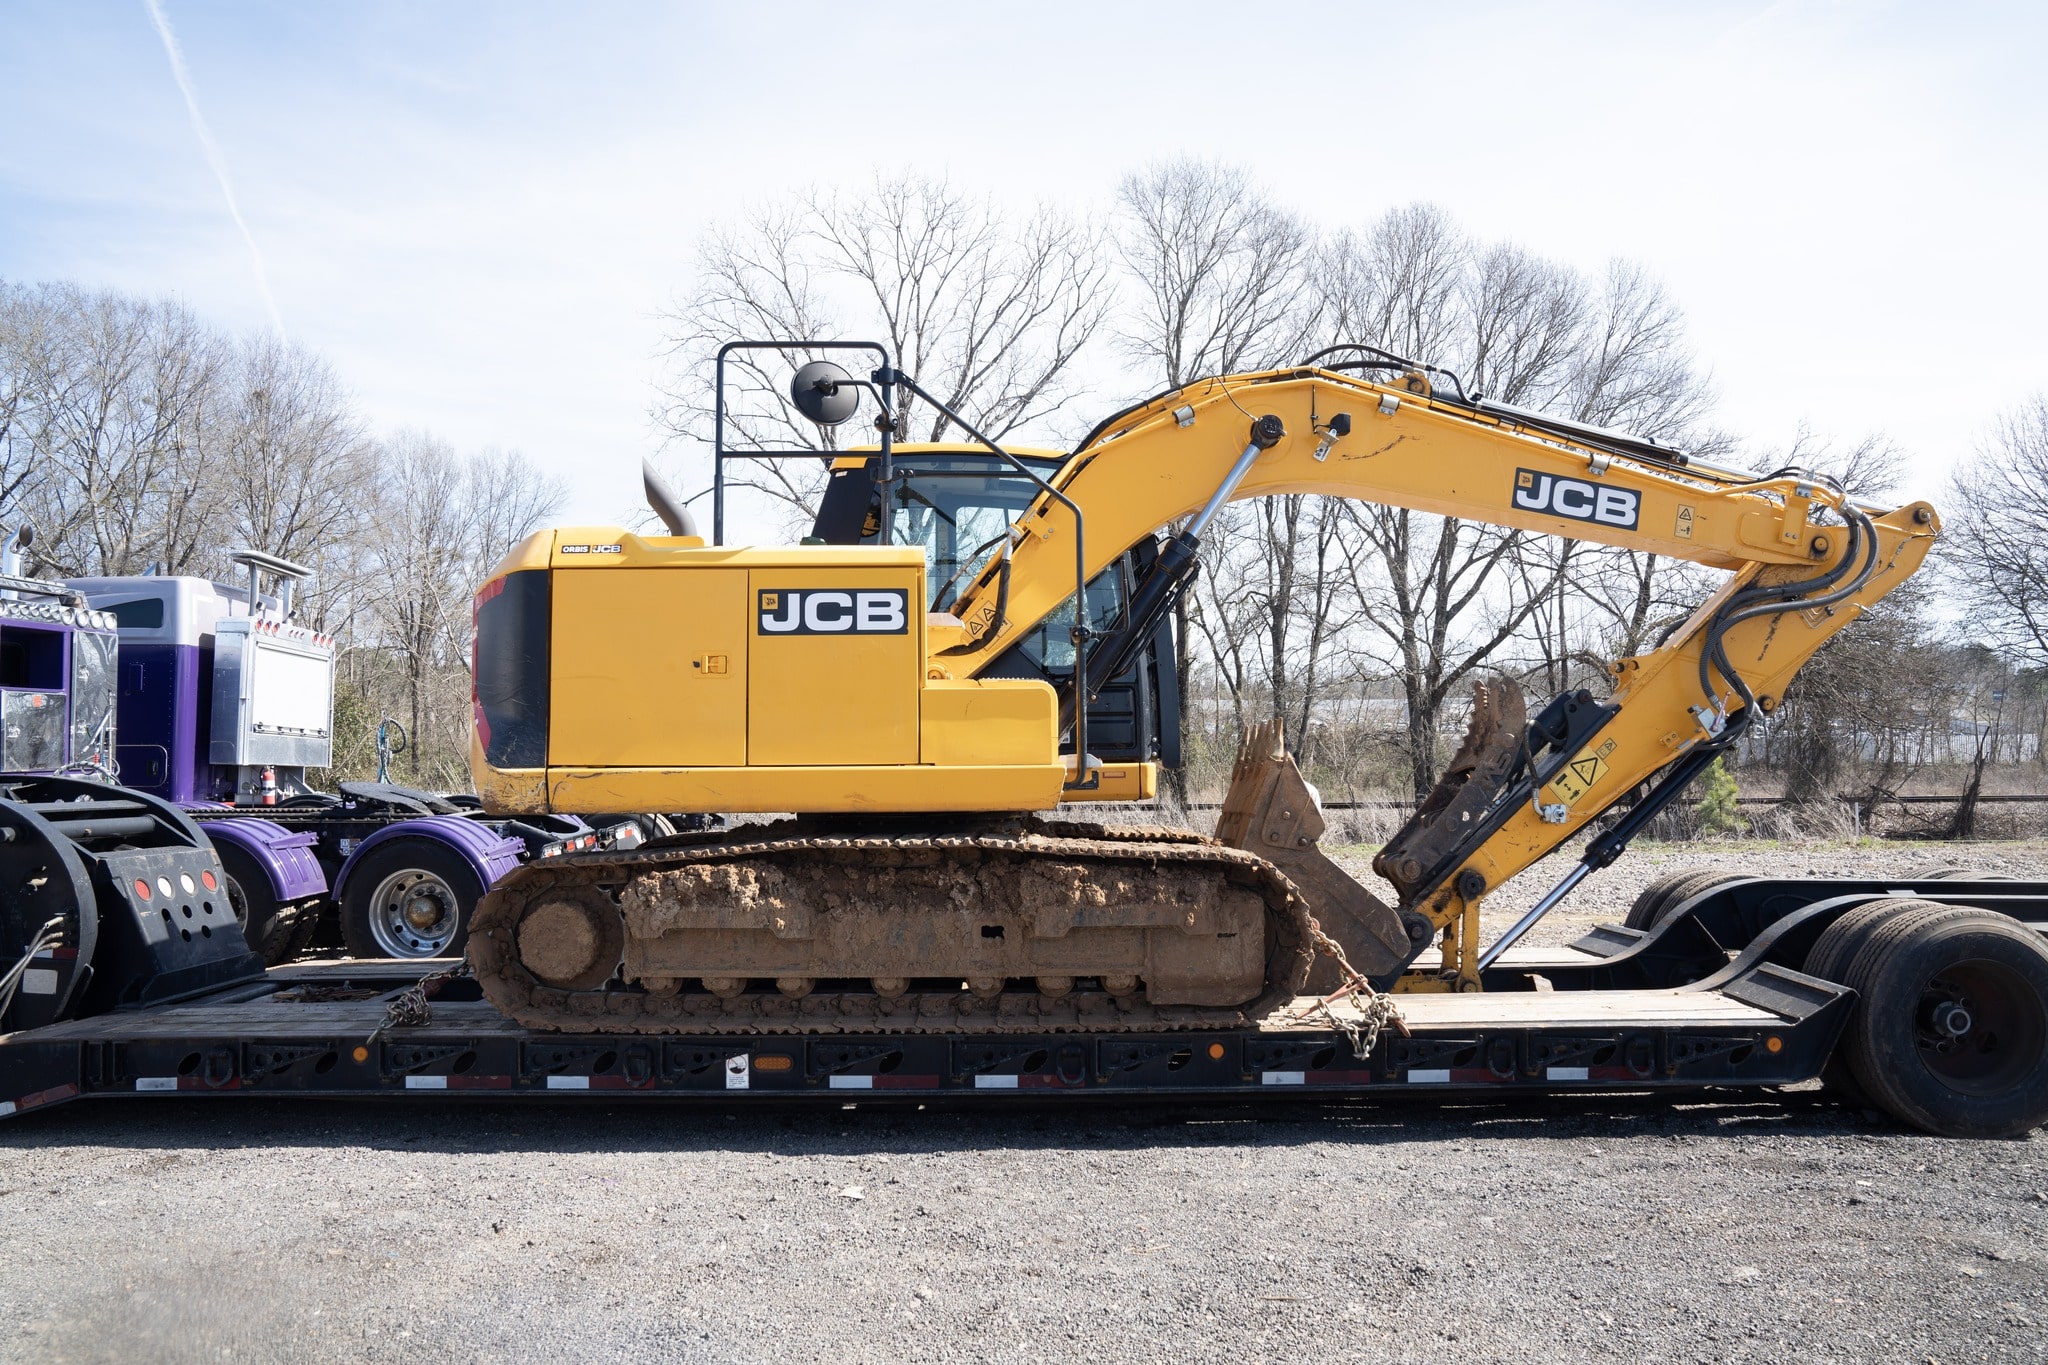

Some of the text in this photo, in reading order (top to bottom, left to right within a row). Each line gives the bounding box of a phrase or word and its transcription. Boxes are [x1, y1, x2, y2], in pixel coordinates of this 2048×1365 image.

[1516, 475, 1637, 526] JCB
[562, 545, 621, 553] ORBIS JCB
[761, 592, 905, 632] JCB
